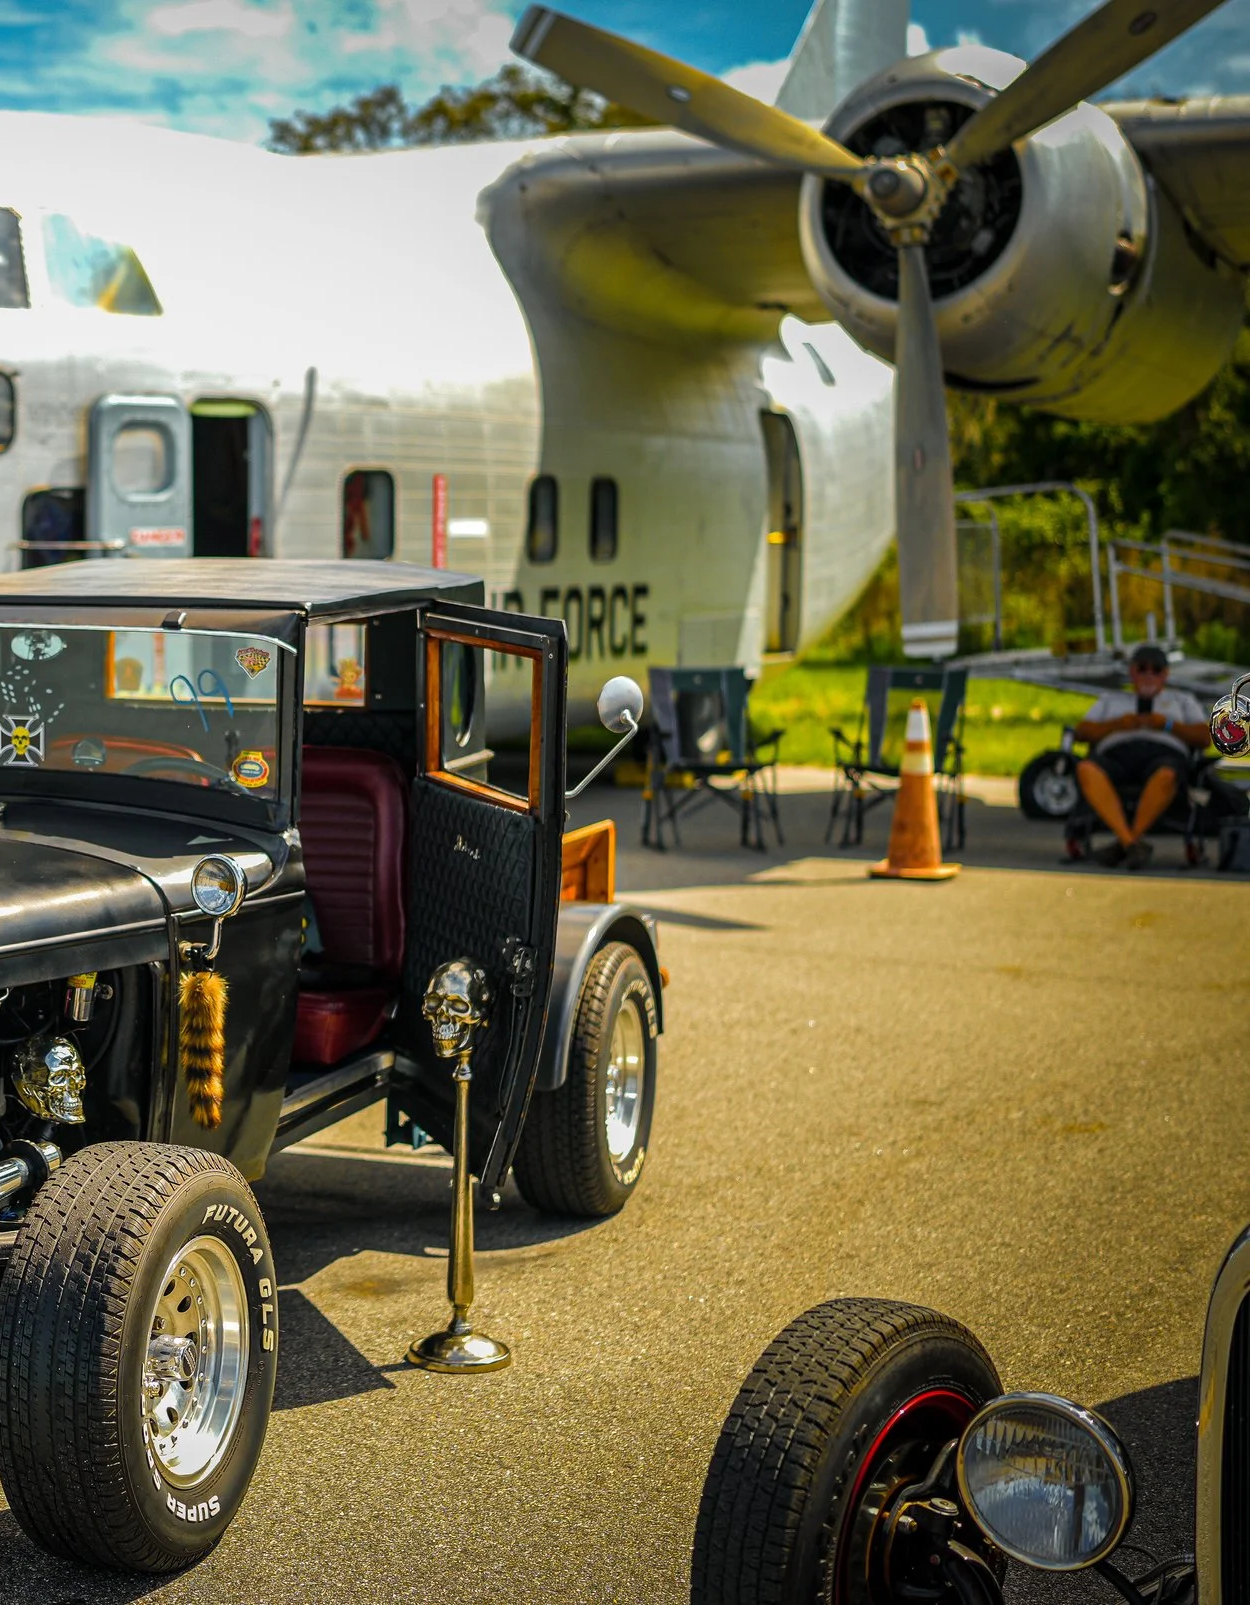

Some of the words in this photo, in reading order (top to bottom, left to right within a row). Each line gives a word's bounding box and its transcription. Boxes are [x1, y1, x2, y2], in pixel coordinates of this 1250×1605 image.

[170, 669, 235, 733] 99
[202, 1204, 264, 1265] FUTURA
[259, 1277, 275, 1353] GLS
[166, 1492, 221, 1522] SUPER
